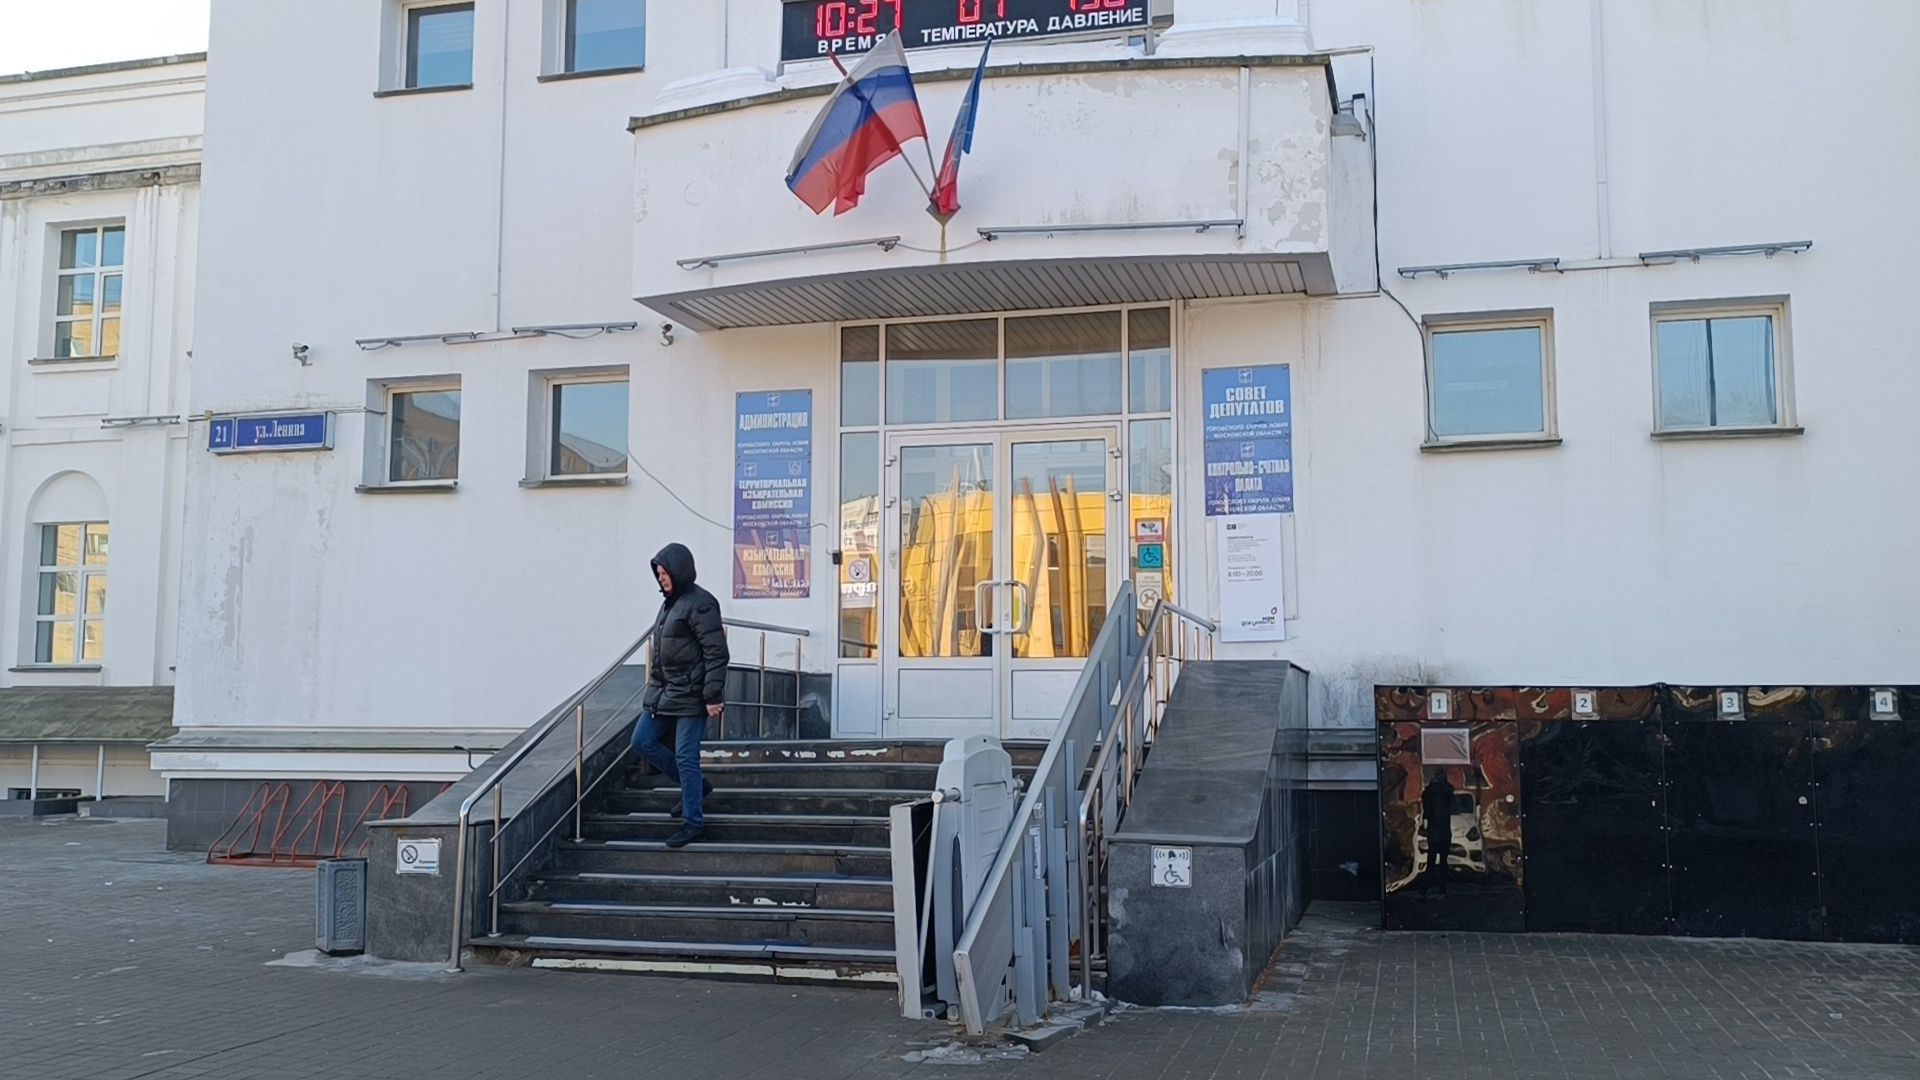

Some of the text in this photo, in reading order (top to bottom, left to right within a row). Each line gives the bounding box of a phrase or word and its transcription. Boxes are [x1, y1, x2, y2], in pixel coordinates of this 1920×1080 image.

[817, 0, 903, 37] 10:27
[921, 19, 1039, 43] ТЕМПЕРАТУРА
[1047, 8, 1143, 31] ДАВЛЕНИЕ
[1226, 385, 1267, 402] СОВЕТ
[1209, 400, 1285, 419] ДЕПУТАТОВ
[739, 411, 809, 431] АДМИНИСТРАЦИЯ
[215, 425, 227, 442] 21
[270, 420, 305, 438] Ленина
[738, 478, 807, 489] ТЕРРИТОРИАЛЬНАЯ
[1234, 477, 1263, 492] ПАЛАТА
[742, 489, 803, 500] ИЗБИРАТЕЛЬНАЯ
[751, 500, 793, 510] КОМИССИЯ
[1436, 699, 1442, 709] 1
[1580, 698, 1588, 708] 2
[1726, 697, 1735, 709] 3
[1880, 697, 1889, 708] 4
